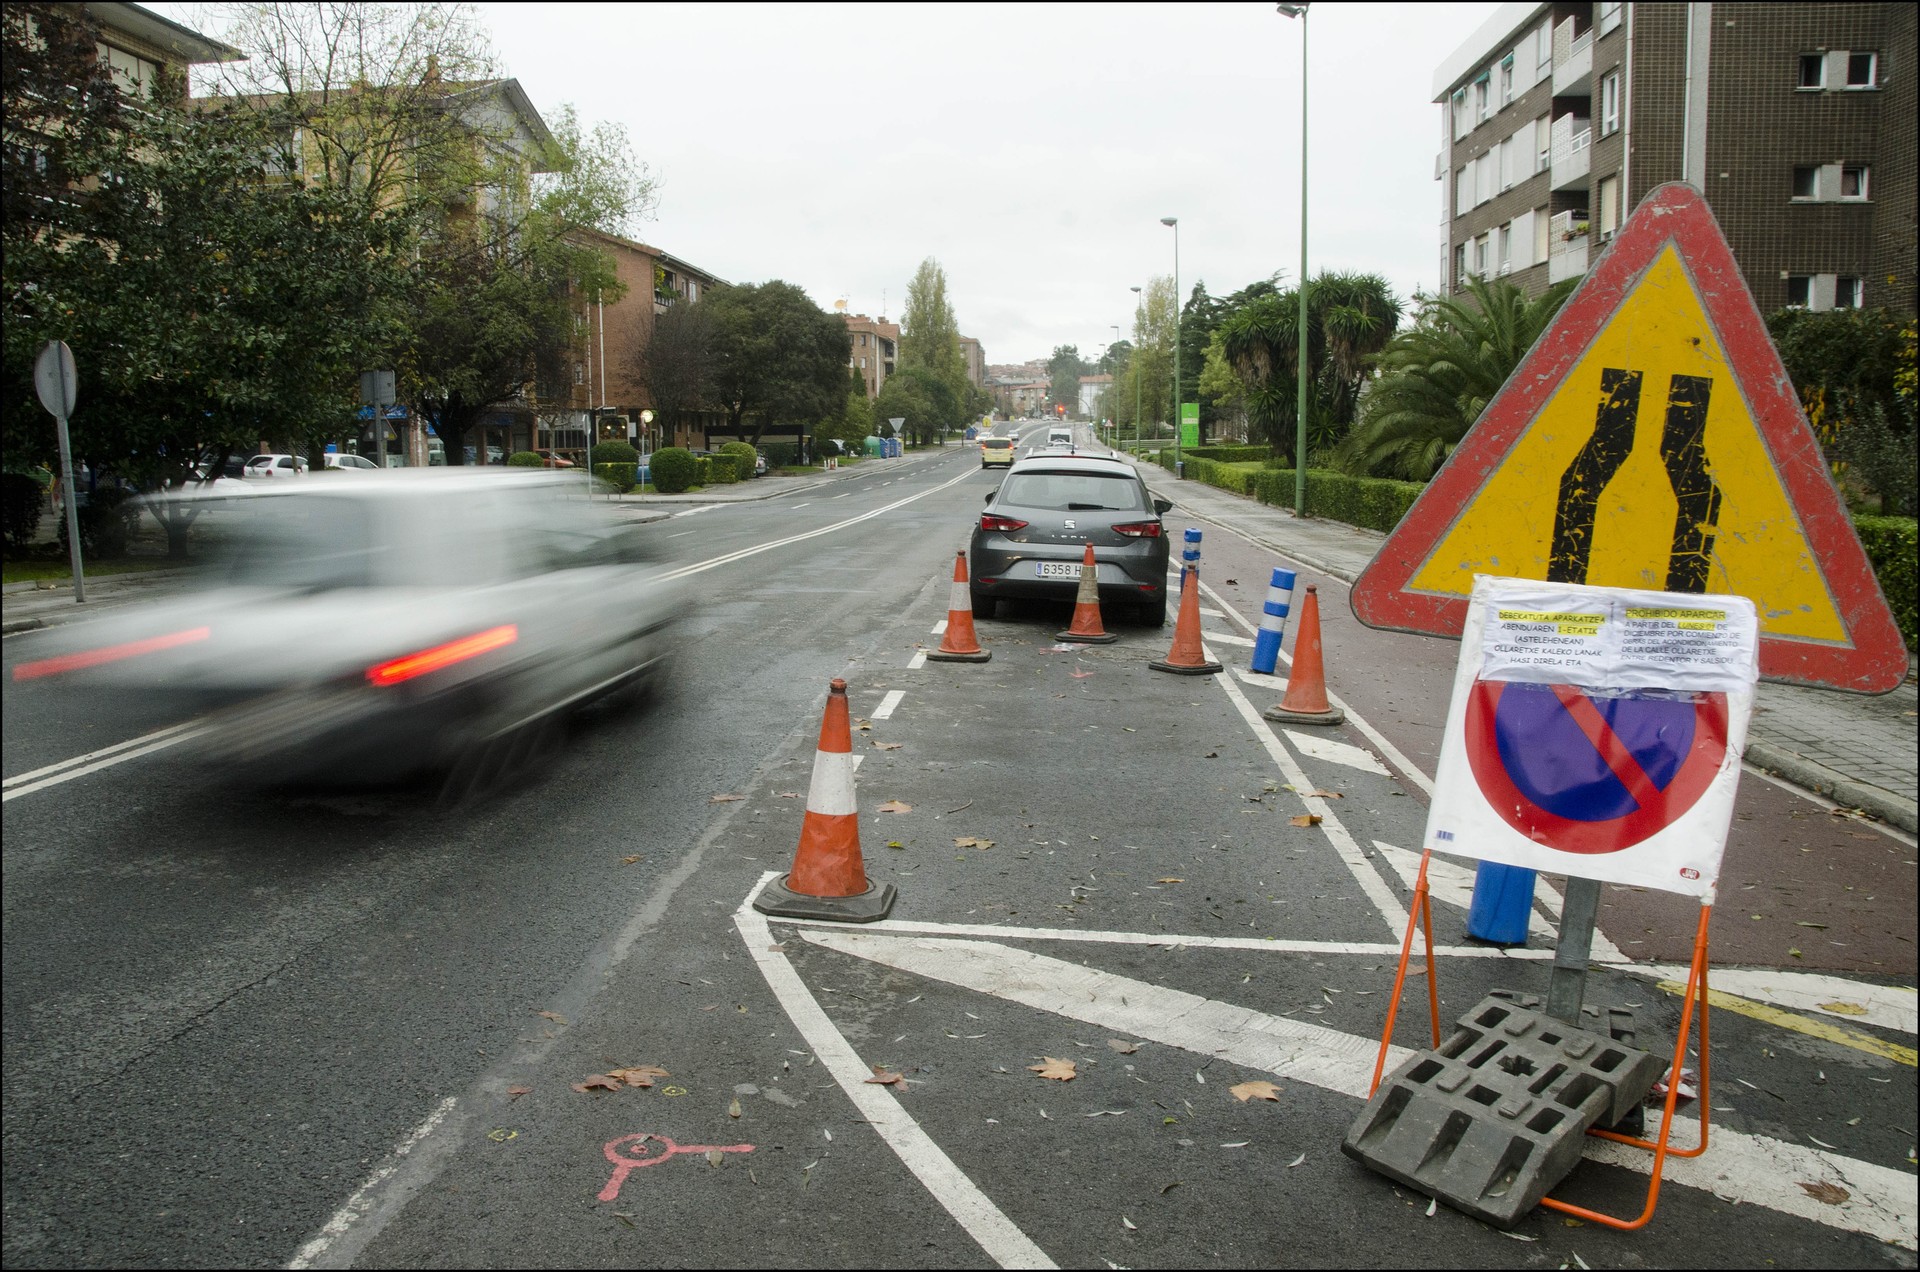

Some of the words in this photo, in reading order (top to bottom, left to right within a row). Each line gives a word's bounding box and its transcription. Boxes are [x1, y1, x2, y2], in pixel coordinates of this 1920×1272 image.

[1043, 564, 1071, 575] 6358
[1499, 611, 1549, 621] DEBEKATUTA
[1553, 614, 1605, 624] APARKATZEA
[1625, 609, 1678, 618] PROHIBIDO
[1680, 610, 1726, 619] APARCAR
[1501, 623, 1555, 632] ABENDUAREN
[1632, 621, 1660, 629] PARTIR
[1661, 621, 1676, 629] DEL
[1677, 622, 1705, 630] LUNES
[1685, 631, 1729, 639] COMIENZO
[1515, 635, 1585, 646] (ASTELEHENEAN)
[1662, 639, 1739, 647] ACONDICIONAMIENTO
[1494, 645, 1539, 653] OLLARETXE
[1542, 647, 1573, 656] KALEKO
[1575, 649, 1603, 657] LANAK
[1671, 647, 1717, 655] OLLARETXE
[1533, 657, 1562, 666] DIRELA
[1648, 655, 1692, 664] REDENTOR
